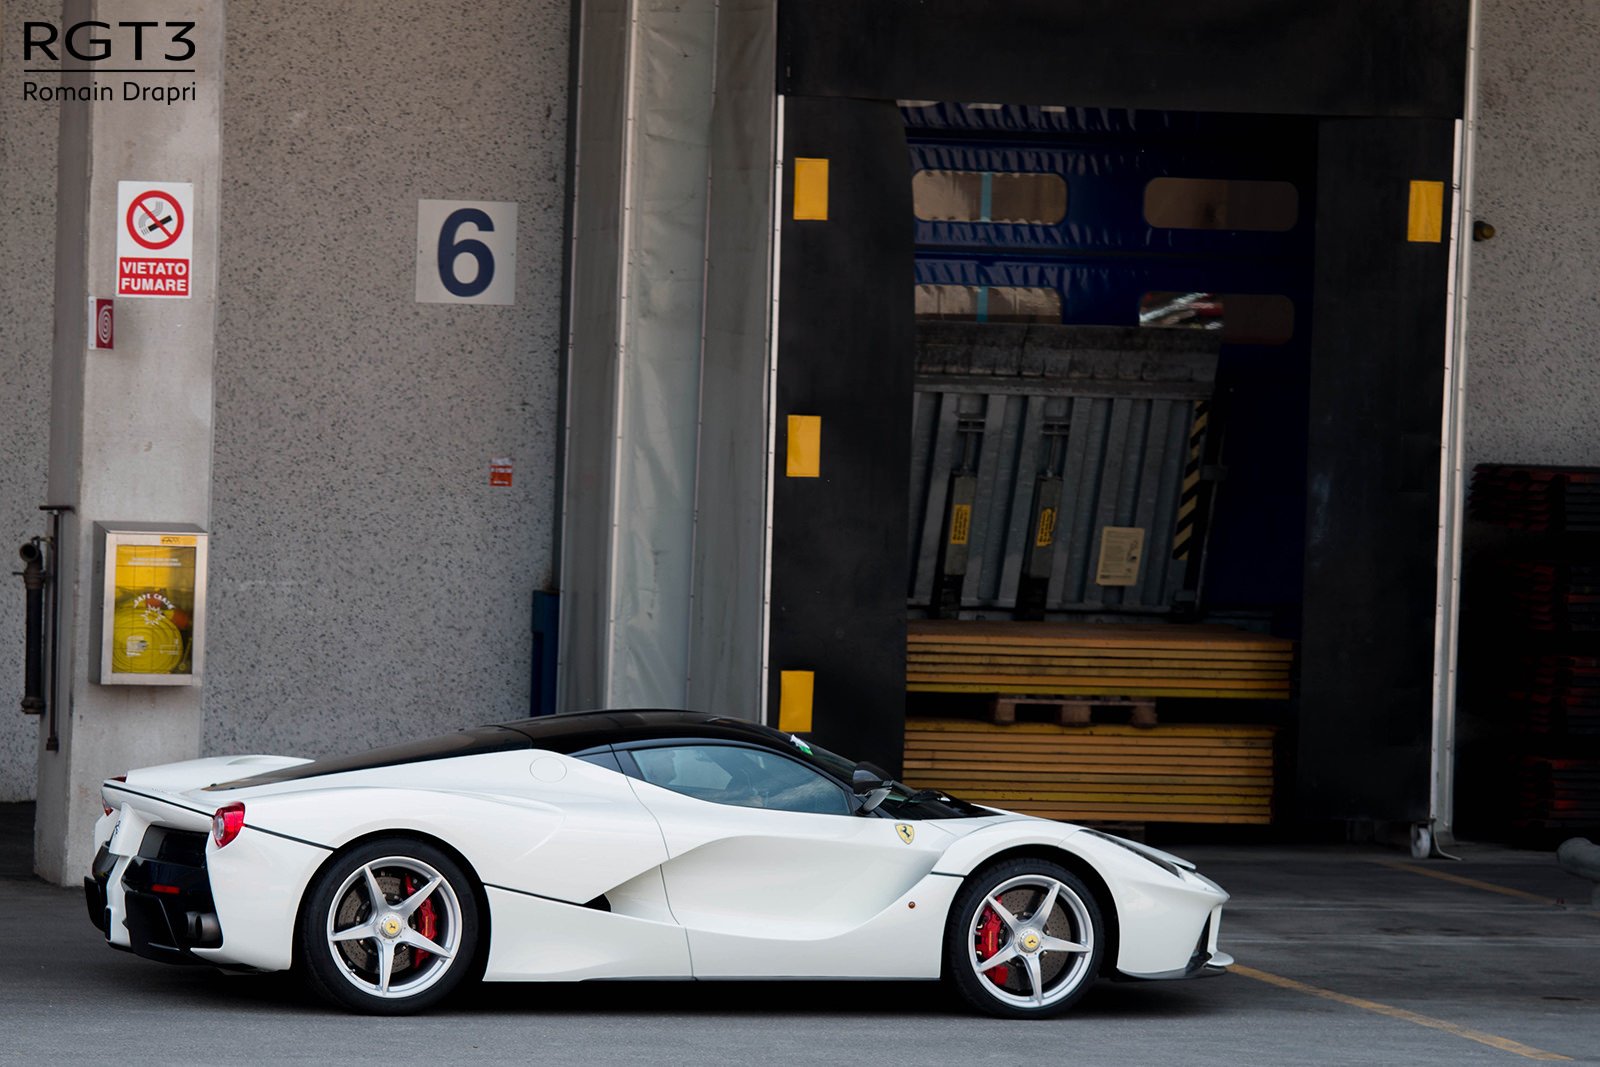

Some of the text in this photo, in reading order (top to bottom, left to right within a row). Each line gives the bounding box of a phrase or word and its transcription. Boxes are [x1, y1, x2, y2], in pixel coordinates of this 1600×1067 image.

[437, 208, 496, 298] 6
[122, 261, 187, 276] VIETATO
[121, 278, 187, 292] FUMARE
